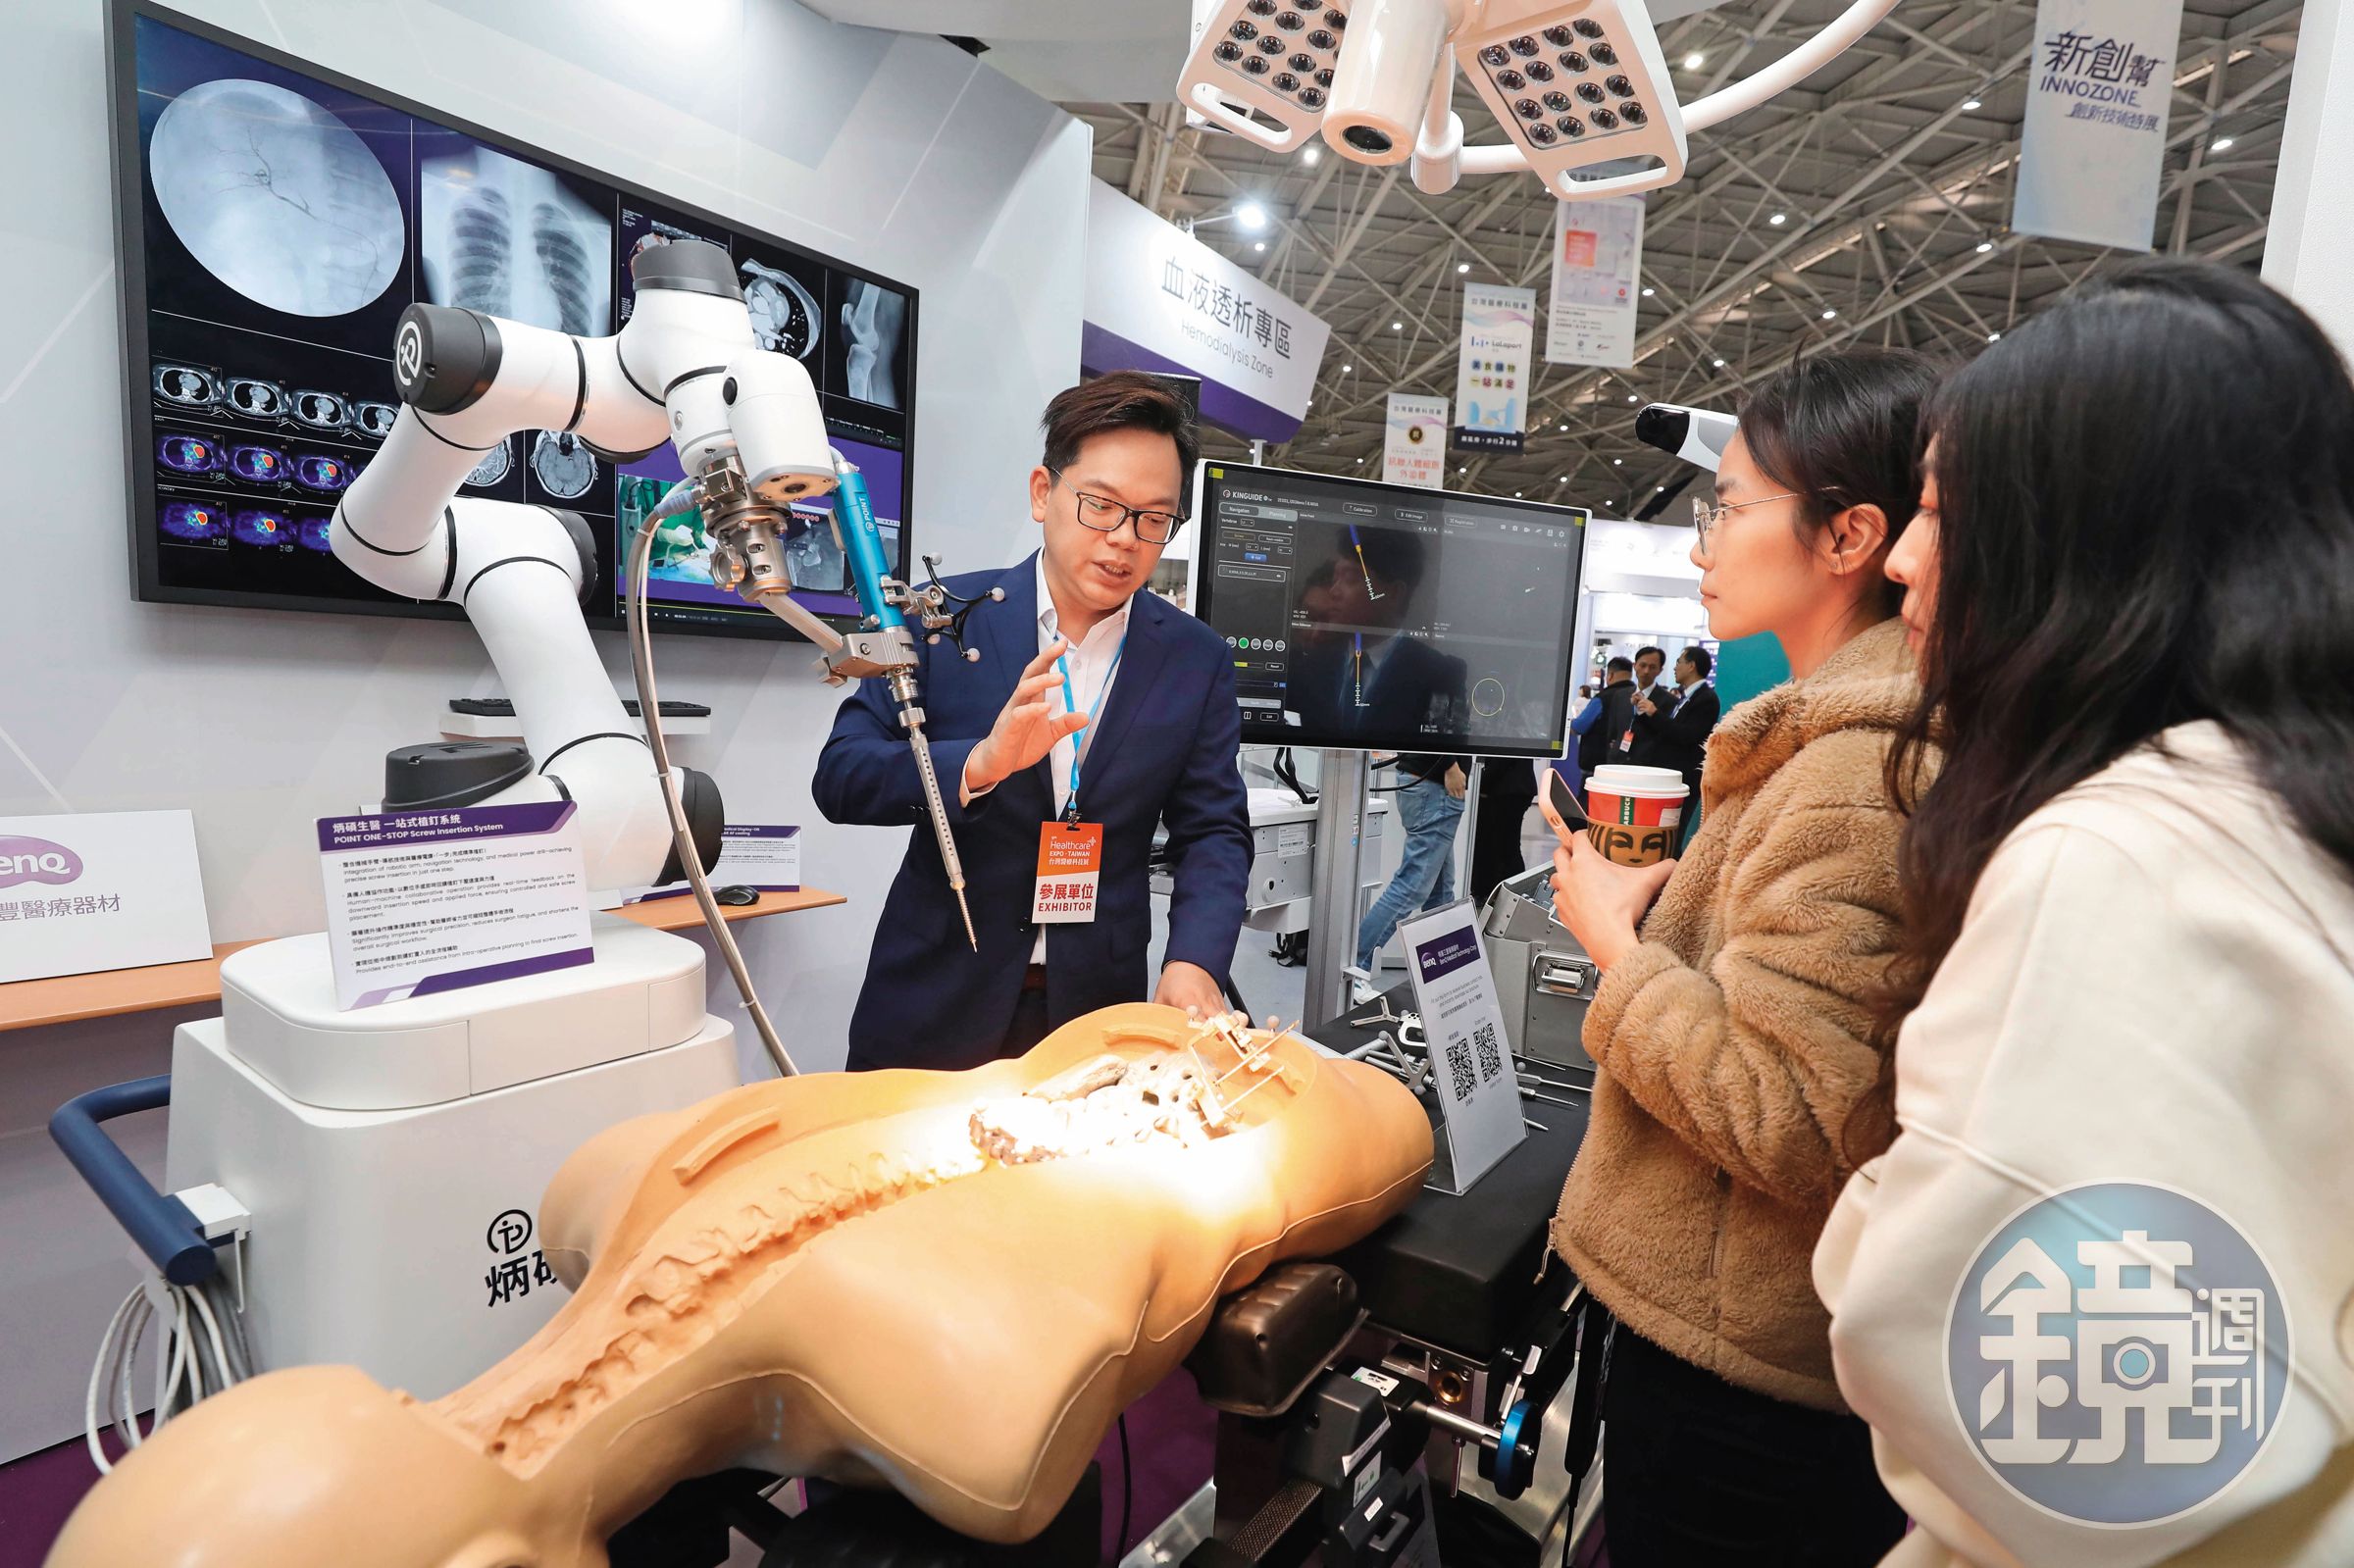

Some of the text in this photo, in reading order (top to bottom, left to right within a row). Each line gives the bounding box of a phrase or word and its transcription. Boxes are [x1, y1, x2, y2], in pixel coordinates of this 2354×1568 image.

[2040, 76, 2141, 108] INNOZONE
[1161, 256, 1292, 360] 血液透析專區
[1181, 319, 1274, 379] Hemodialysis Zone
[1232, 491, 1263, 502] KINGUIDE
[858, 496, 871, 521] POINT
[333, 814, 461, 833] 炳碩生醫 一站式植釘系統
[363, 832, 408, 841] ONE-STOP
[437, 826, 473, 835] Insertion
[474, 824, 503, 833] System
[1050, 840, 1091, 850] Healthcare
[1040, 883, 1094, 900] 參展單位
[0, 893, 121, 922] 豐醫療器材
[1038, 902, 1092, 912] EXHIBITOR
